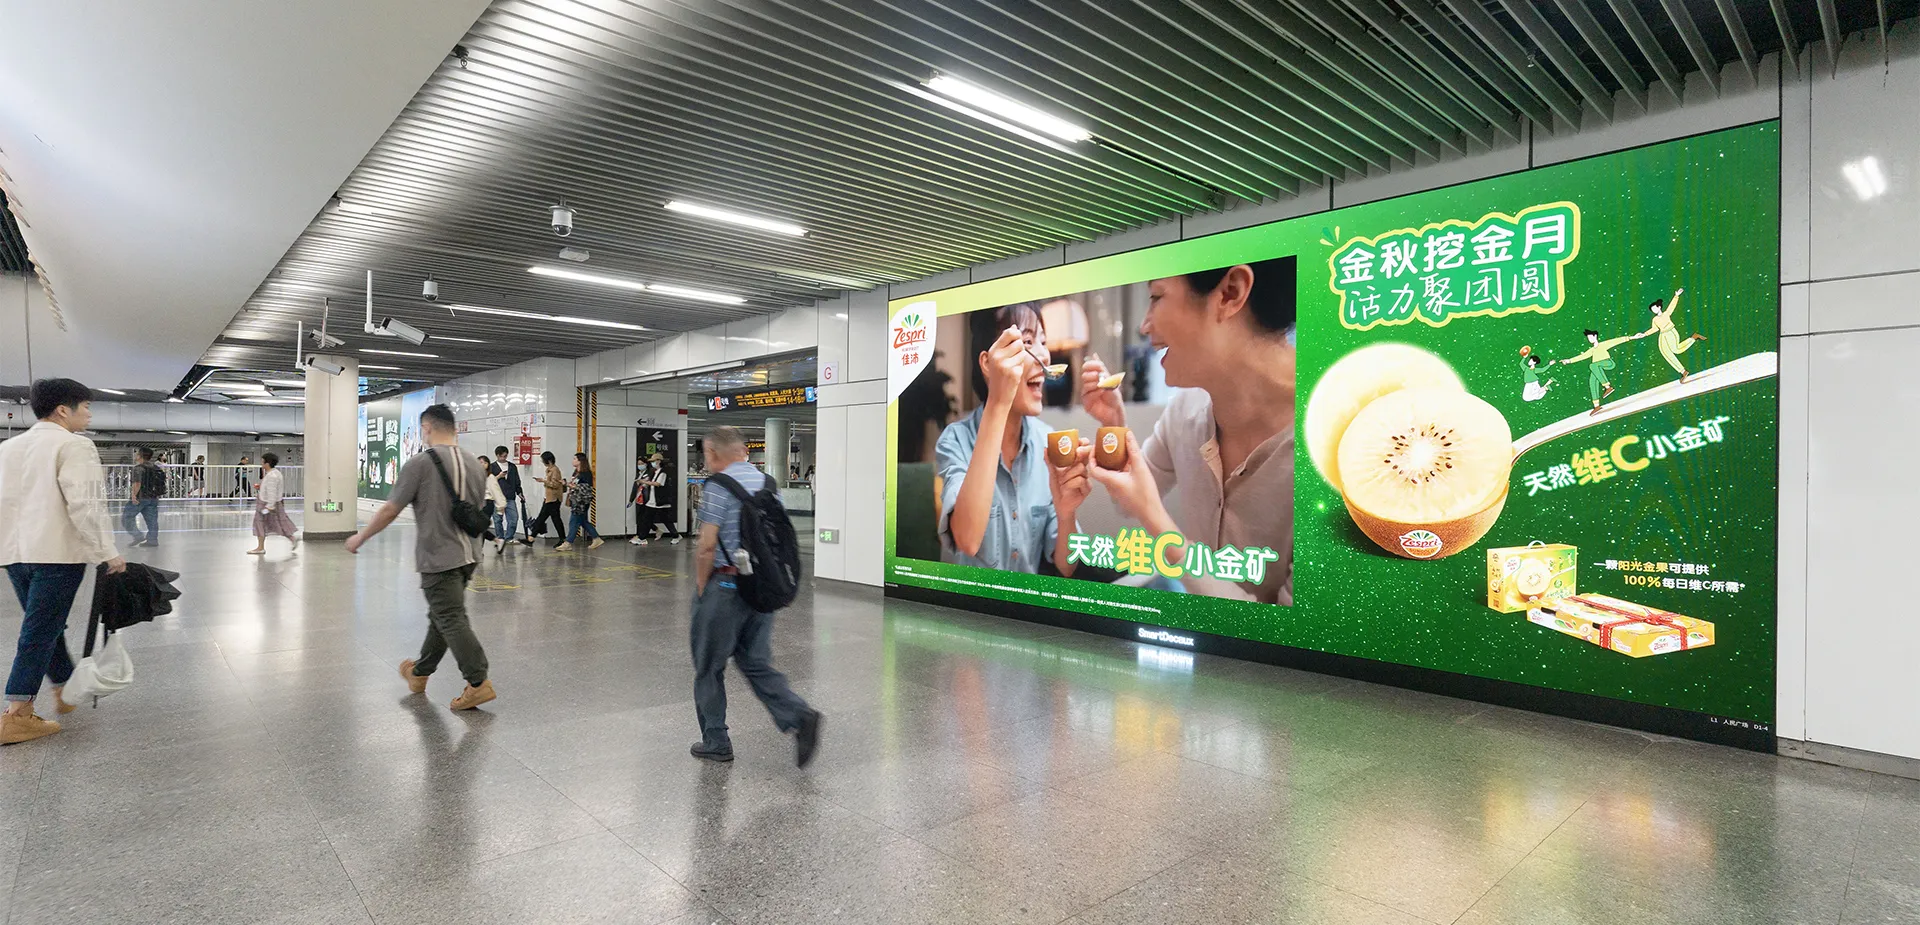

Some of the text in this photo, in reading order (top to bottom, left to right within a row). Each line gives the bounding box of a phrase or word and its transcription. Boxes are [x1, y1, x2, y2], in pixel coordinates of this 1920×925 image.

[1339, 213, 1566, 285] 金秋挖金月
[1349, 259, 1551, 320] 活力聚团圆
[894, 326, 927, 349] Zespri
[901, 352, 919, 366] 佳沛
[824, 366, 832, 380] G
[1523, 416, 1730, 497] 天然维C小金矿
[1400, 536, 1438, 548] Zespri
[1067, 528, 1279, 583] 天然维C小金矿
[1593, 559, 1710, 576] 一颗阳光金果可提供
[1723, 719, 1749, 729] 人民广场
